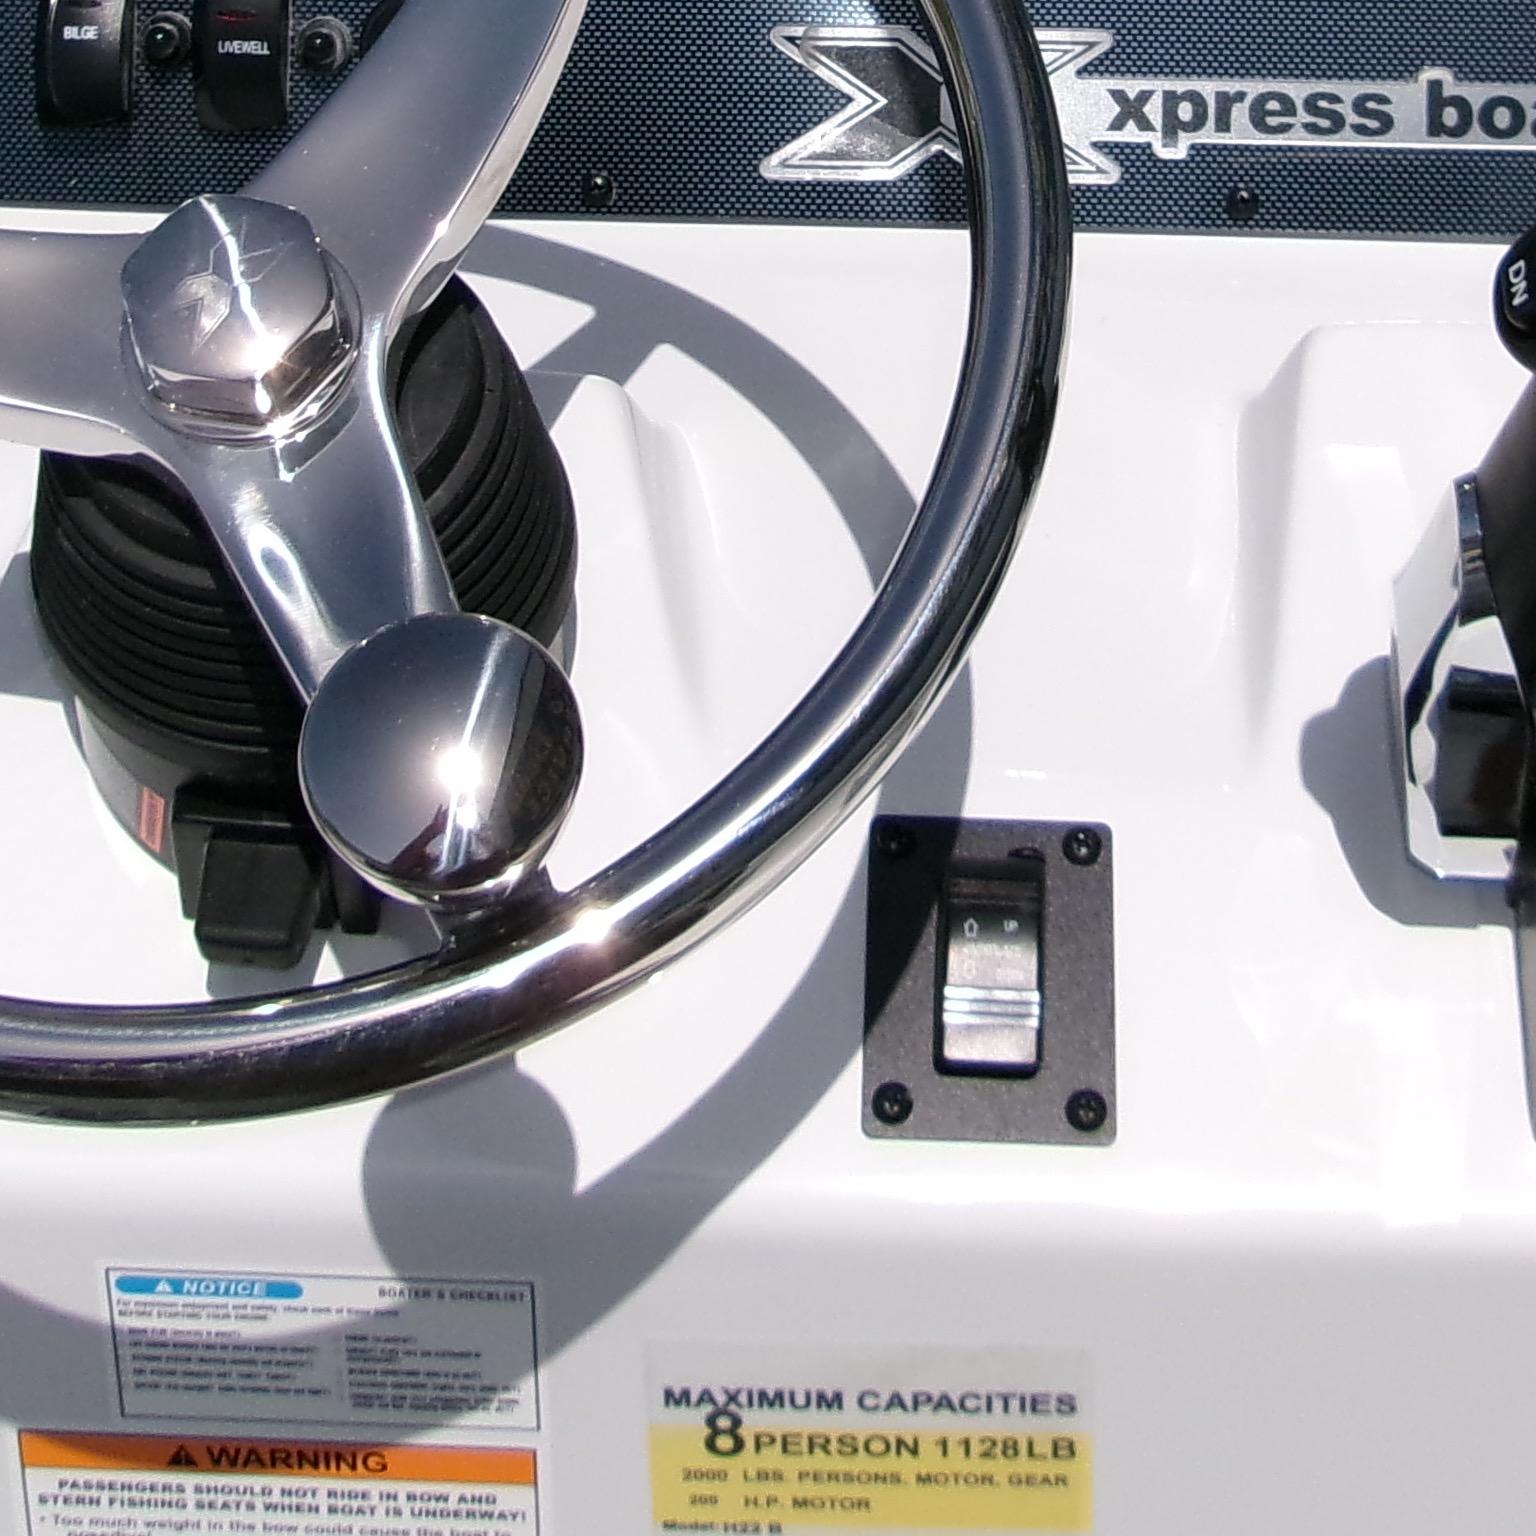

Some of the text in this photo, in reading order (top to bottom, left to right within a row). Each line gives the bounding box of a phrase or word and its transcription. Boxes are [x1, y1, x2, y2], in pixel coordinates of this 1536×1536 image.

[63, 25, 99, 40] BILGE
[218, 40, 271, 55] LIVEWELL
[1106, 87, 1395, 148] xpress
[1508, 259, 1529, 306] DN
[182, 1280, 267, 1296] NOTICE
[664, 1386, 1078, 1414] MAXIMUM CAPACITIES
[705, 1407, 745, 1456] 8
[753, 1432, 920, 1457] PERSON
[206, 1445, 389, 1473] WARNING
[58, 1478, 497, 1506] PASSENGERS SHOULD NOT RIDE IN BOW AND
[1008, 1472, 1068, 1487] GEAR
[38, 1492, 102, 1507] STERN
[108, 1495, 188, 1510] FISHING
[194, 1497, 256, 1512] SEATS
[263, 1500, 320, 1515] WHEN
[327, 1503, 376, 1517] BOAT
[385, 1505, 403, 1518] IS
[791, 1496, 871, 1512] MOTOR
[53, 1515, 84, 1527] Too
[89, 1516, 138, 1529] much
[143, 1517, 201, 1532] weight
[208, 1518, 223, 1531] in
[229, 1518, 256, 1533] the
